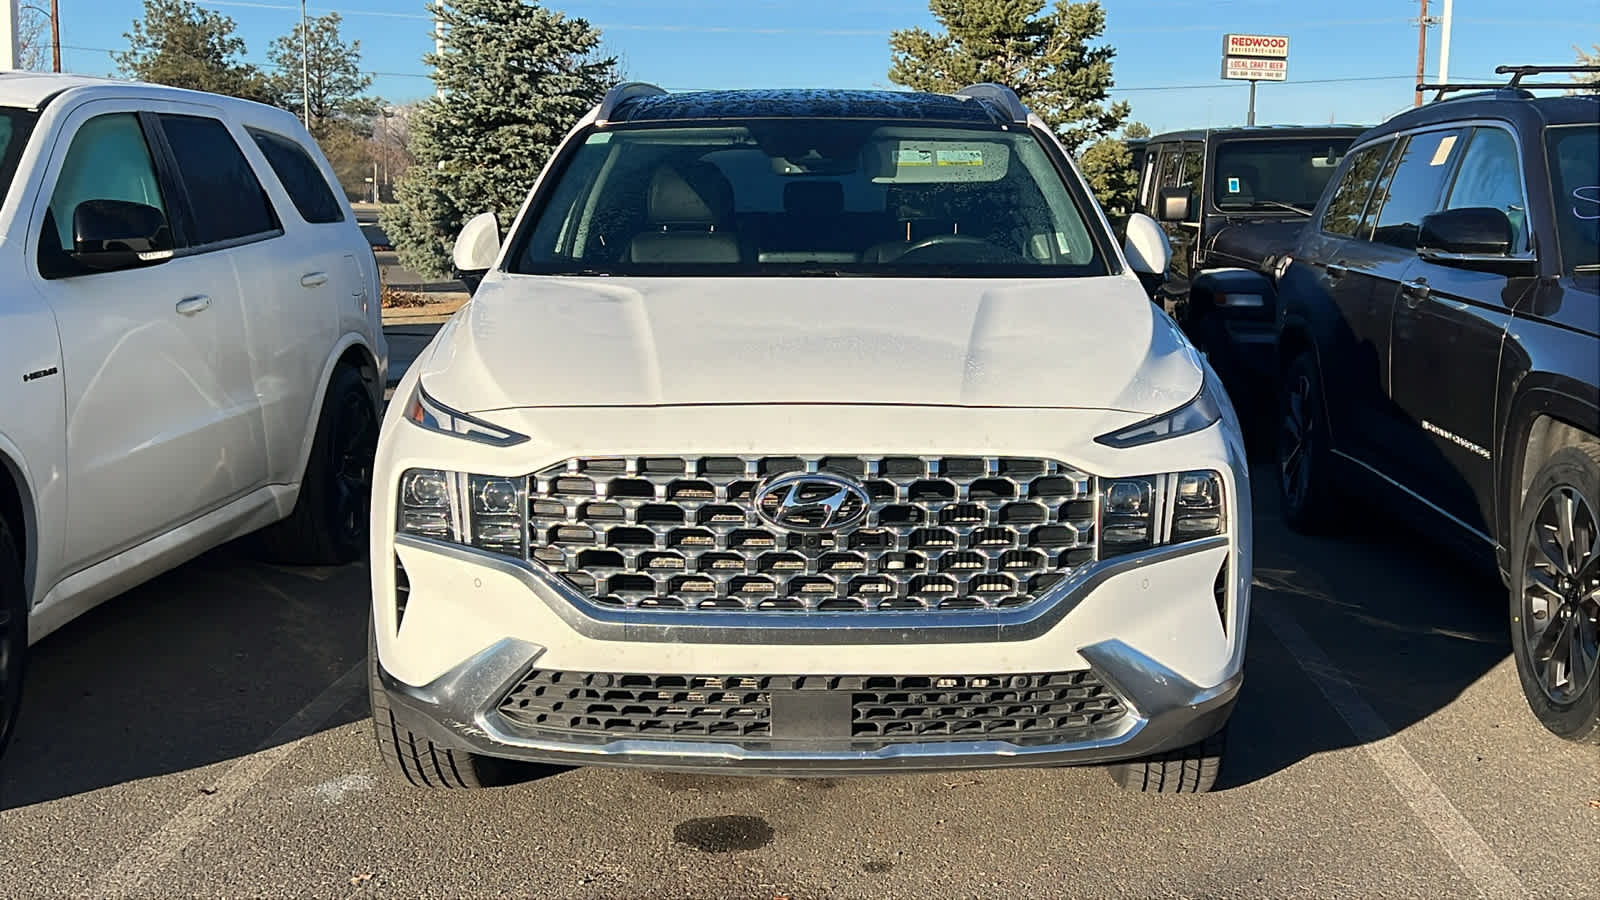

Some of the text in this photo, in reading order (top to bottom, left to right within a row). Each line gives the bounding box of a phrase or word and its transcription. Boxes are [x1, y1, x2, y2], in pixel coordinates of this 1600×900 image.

[1231, 37, 1286, 48] REDWOOD
[1230, 60, 1248, 68] LOCAL
[1249, 61, 1267, 69] CRAFT
